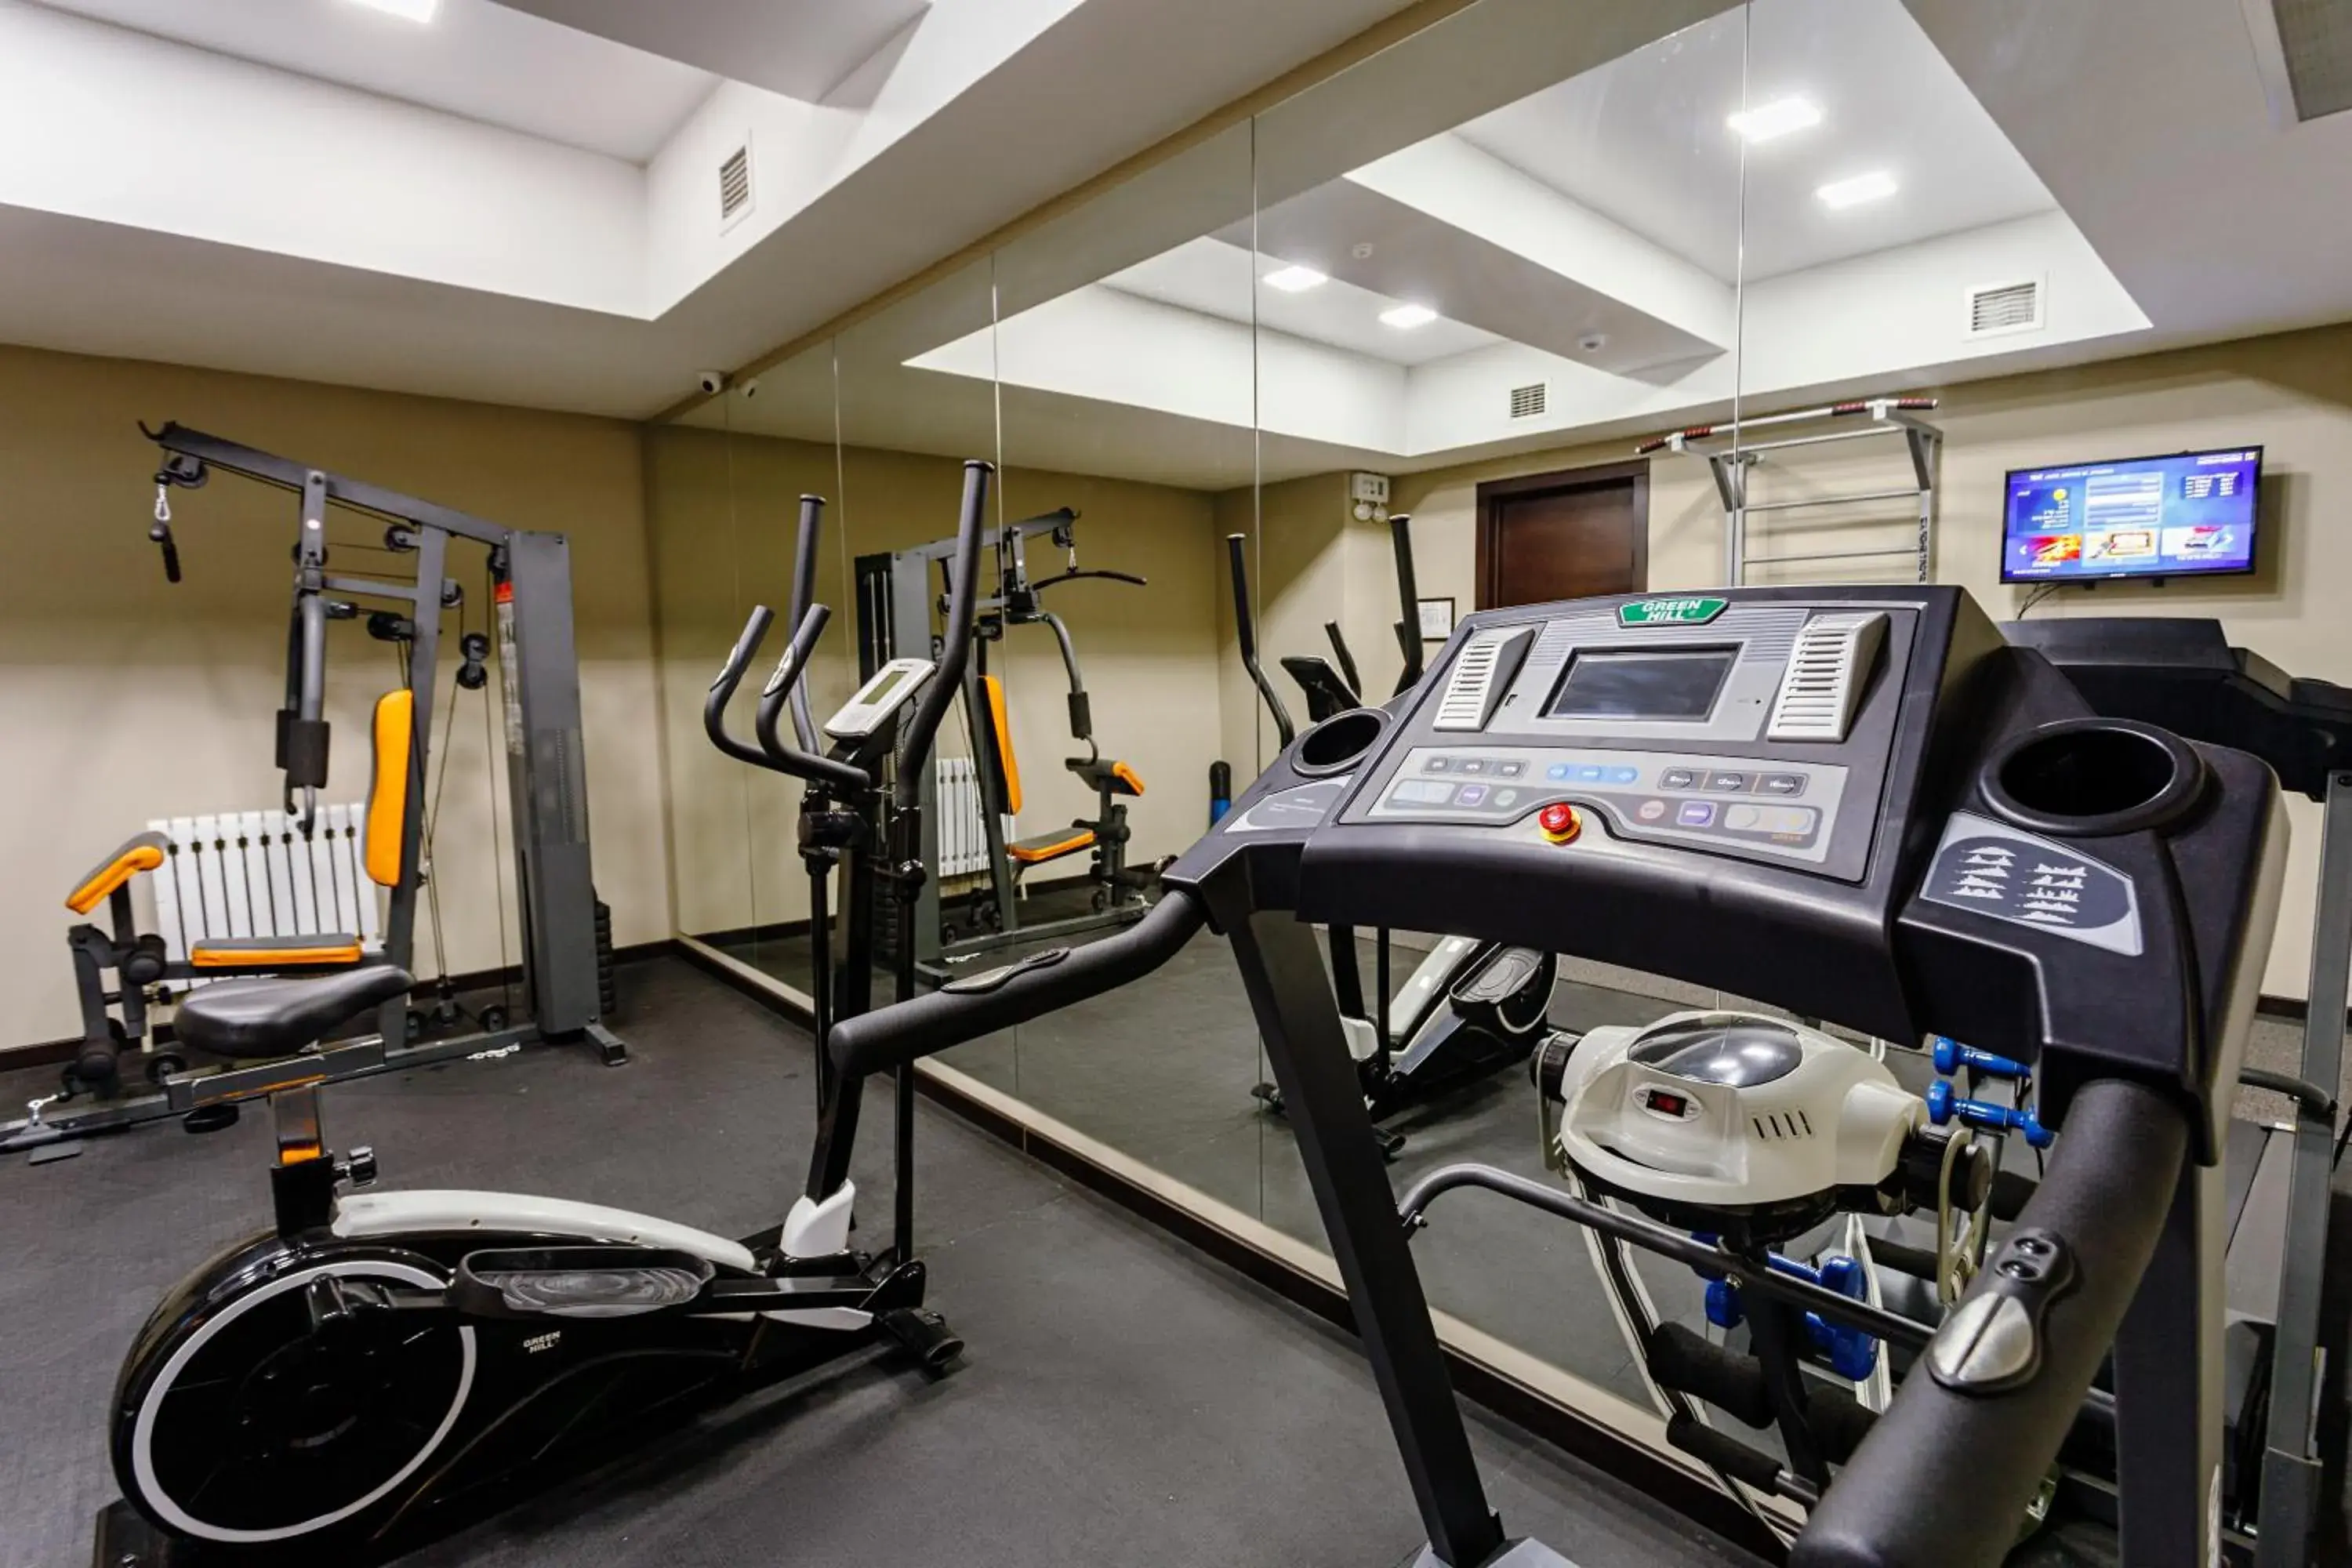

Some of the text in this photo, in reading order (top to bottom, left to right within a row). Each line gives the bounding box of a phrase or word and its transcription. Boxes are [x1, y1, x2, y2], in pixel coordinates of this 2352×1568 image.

[1641, 599, 1702, 612] GREEN
[1647, 609, 1685, 622] HILL
[523, 1330, 561, 1348] GREEN
[529, 1341, 554, 1354] HILL
